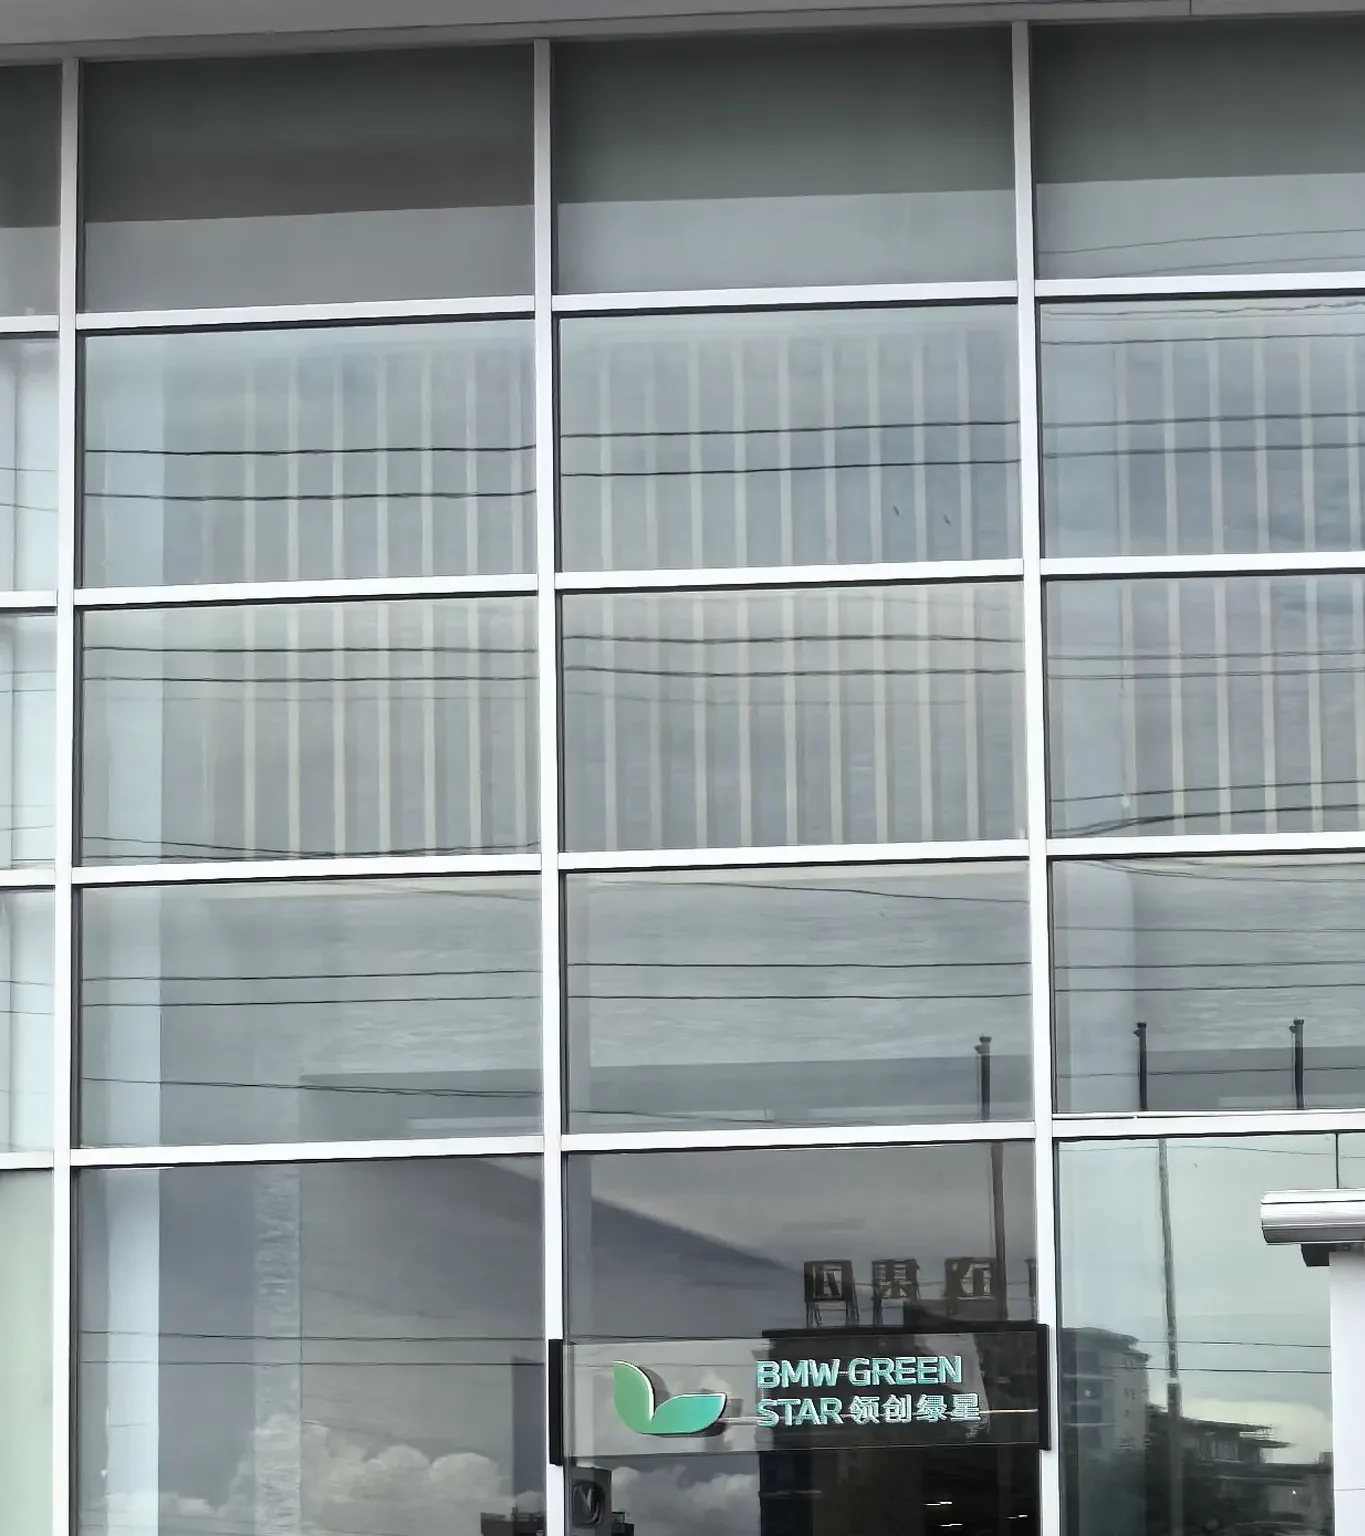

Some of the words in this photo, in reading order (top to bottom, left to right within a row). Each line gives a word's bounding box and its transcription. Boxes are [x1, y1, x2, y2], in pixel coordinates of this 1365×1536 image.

[755, 1358, 841, 1390] BMW
[847, 1354, 963, 1388] GREEN
[755, 1396, 844, 1428] STAR
[848, 1393, 982, 1425] 领创绿星
